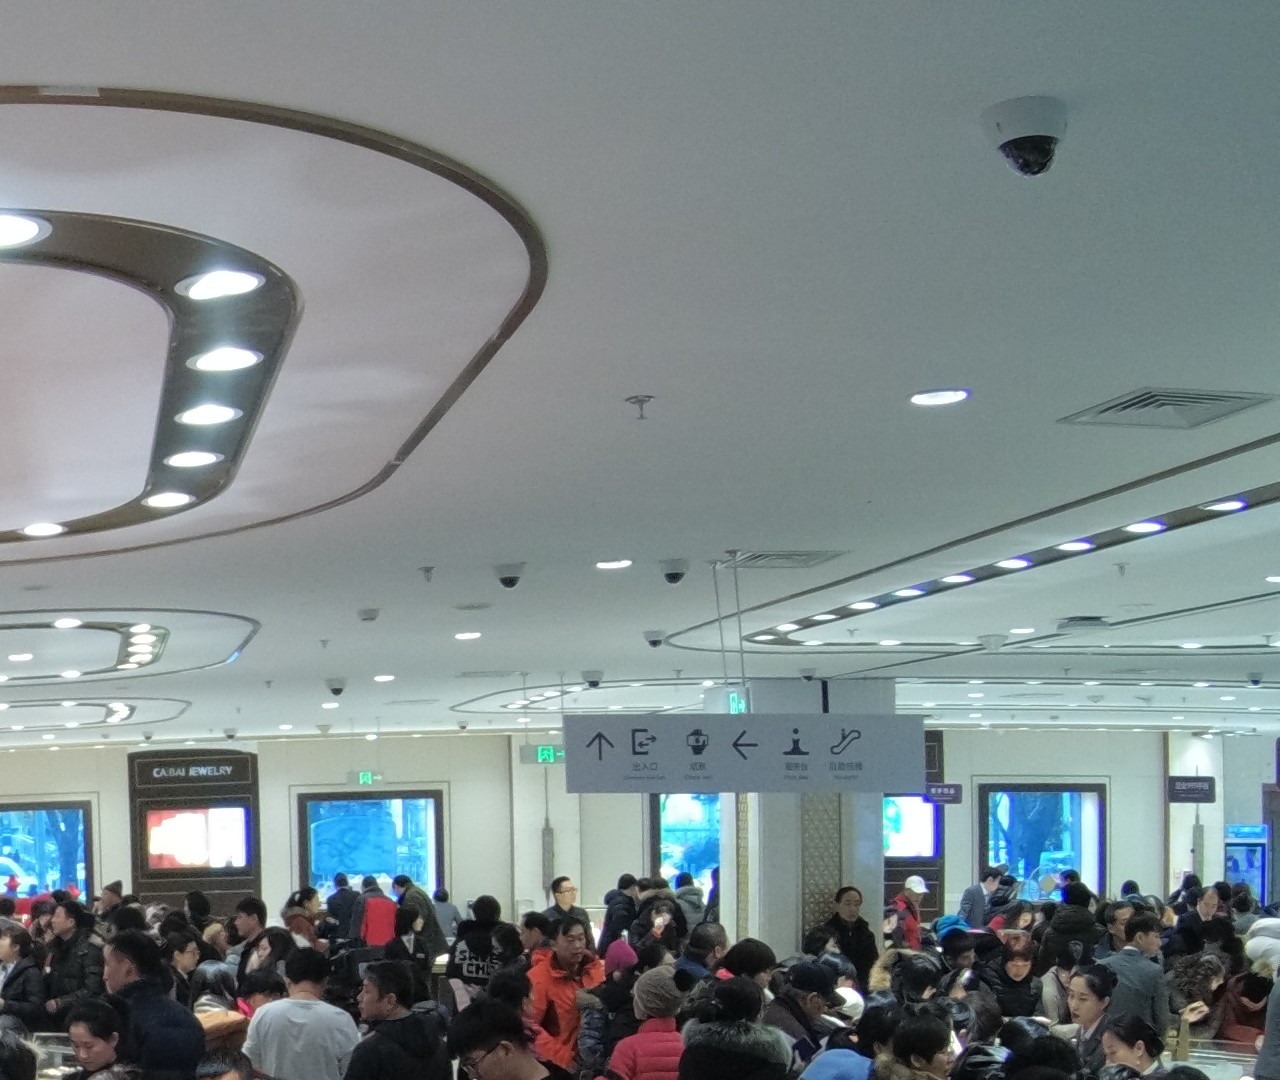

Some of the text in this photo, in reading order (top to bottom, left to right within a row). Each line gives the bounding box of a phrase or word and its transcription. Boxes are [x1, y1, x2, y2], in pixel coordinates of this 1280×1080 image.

[188, 765, 233, 777] JEWELRY
[632, 762, 658, 771] 出入口
